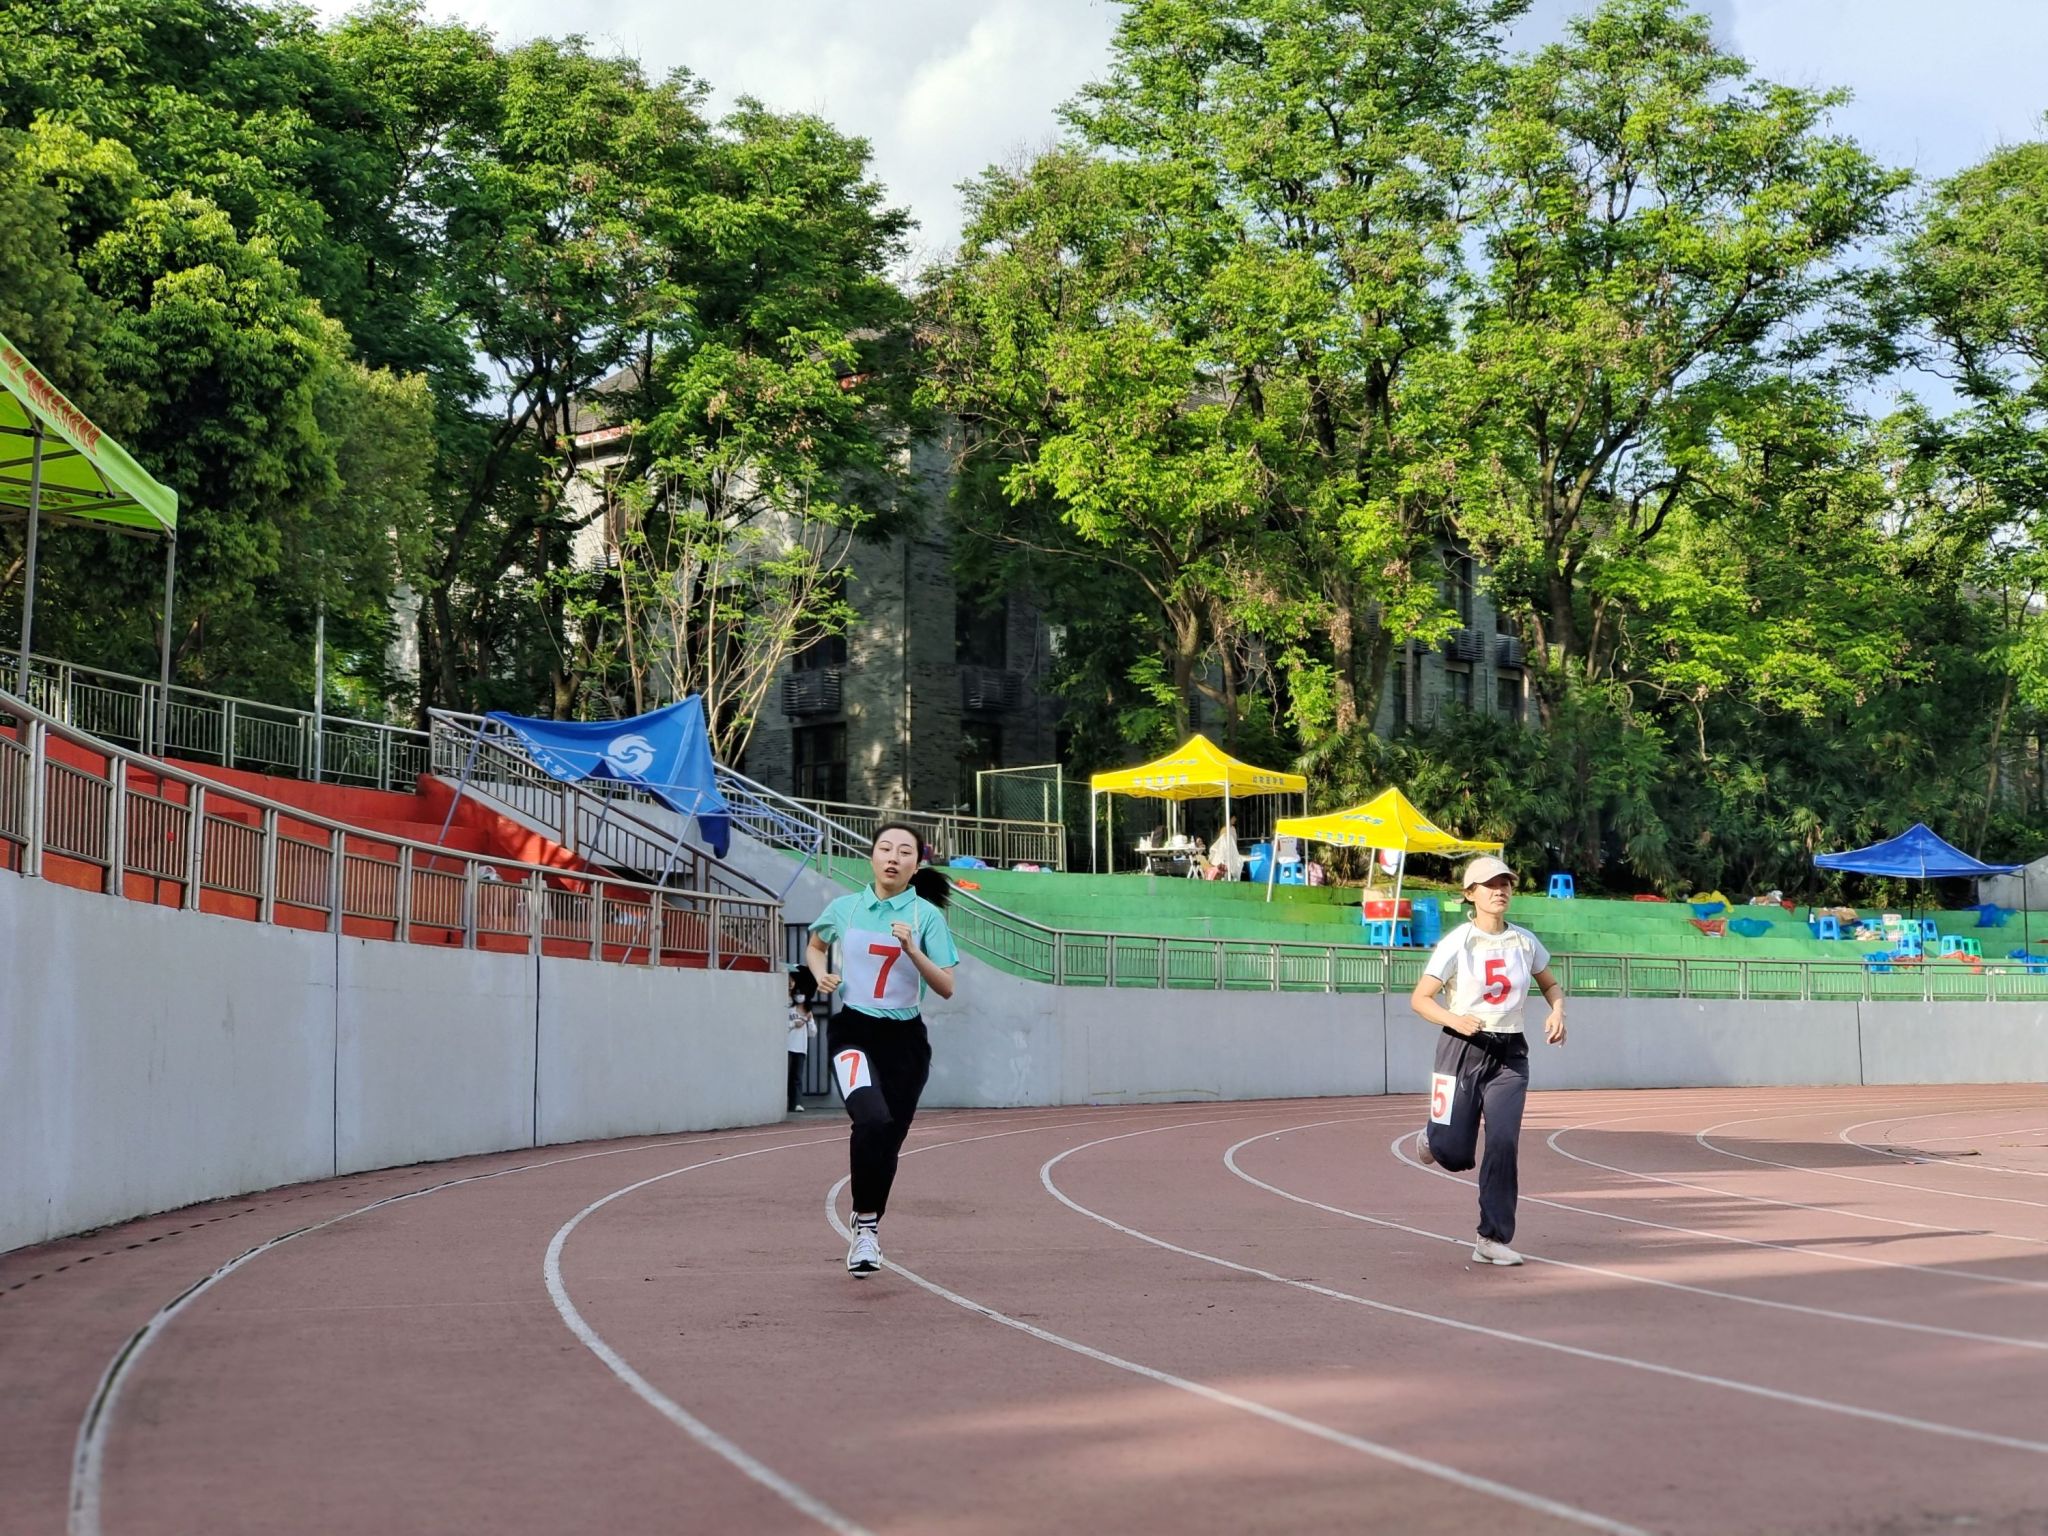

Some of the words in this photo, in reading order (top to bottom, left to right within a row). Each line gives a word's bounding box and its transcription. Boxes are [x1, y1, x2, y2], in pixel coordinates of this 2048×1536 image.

[869, 944, 901, 998] 7
[1483, 959, 1511, 1005] 5
[841, 1053, 860, 1087] 7
[1432, 1079, 1448, 1118] 5
